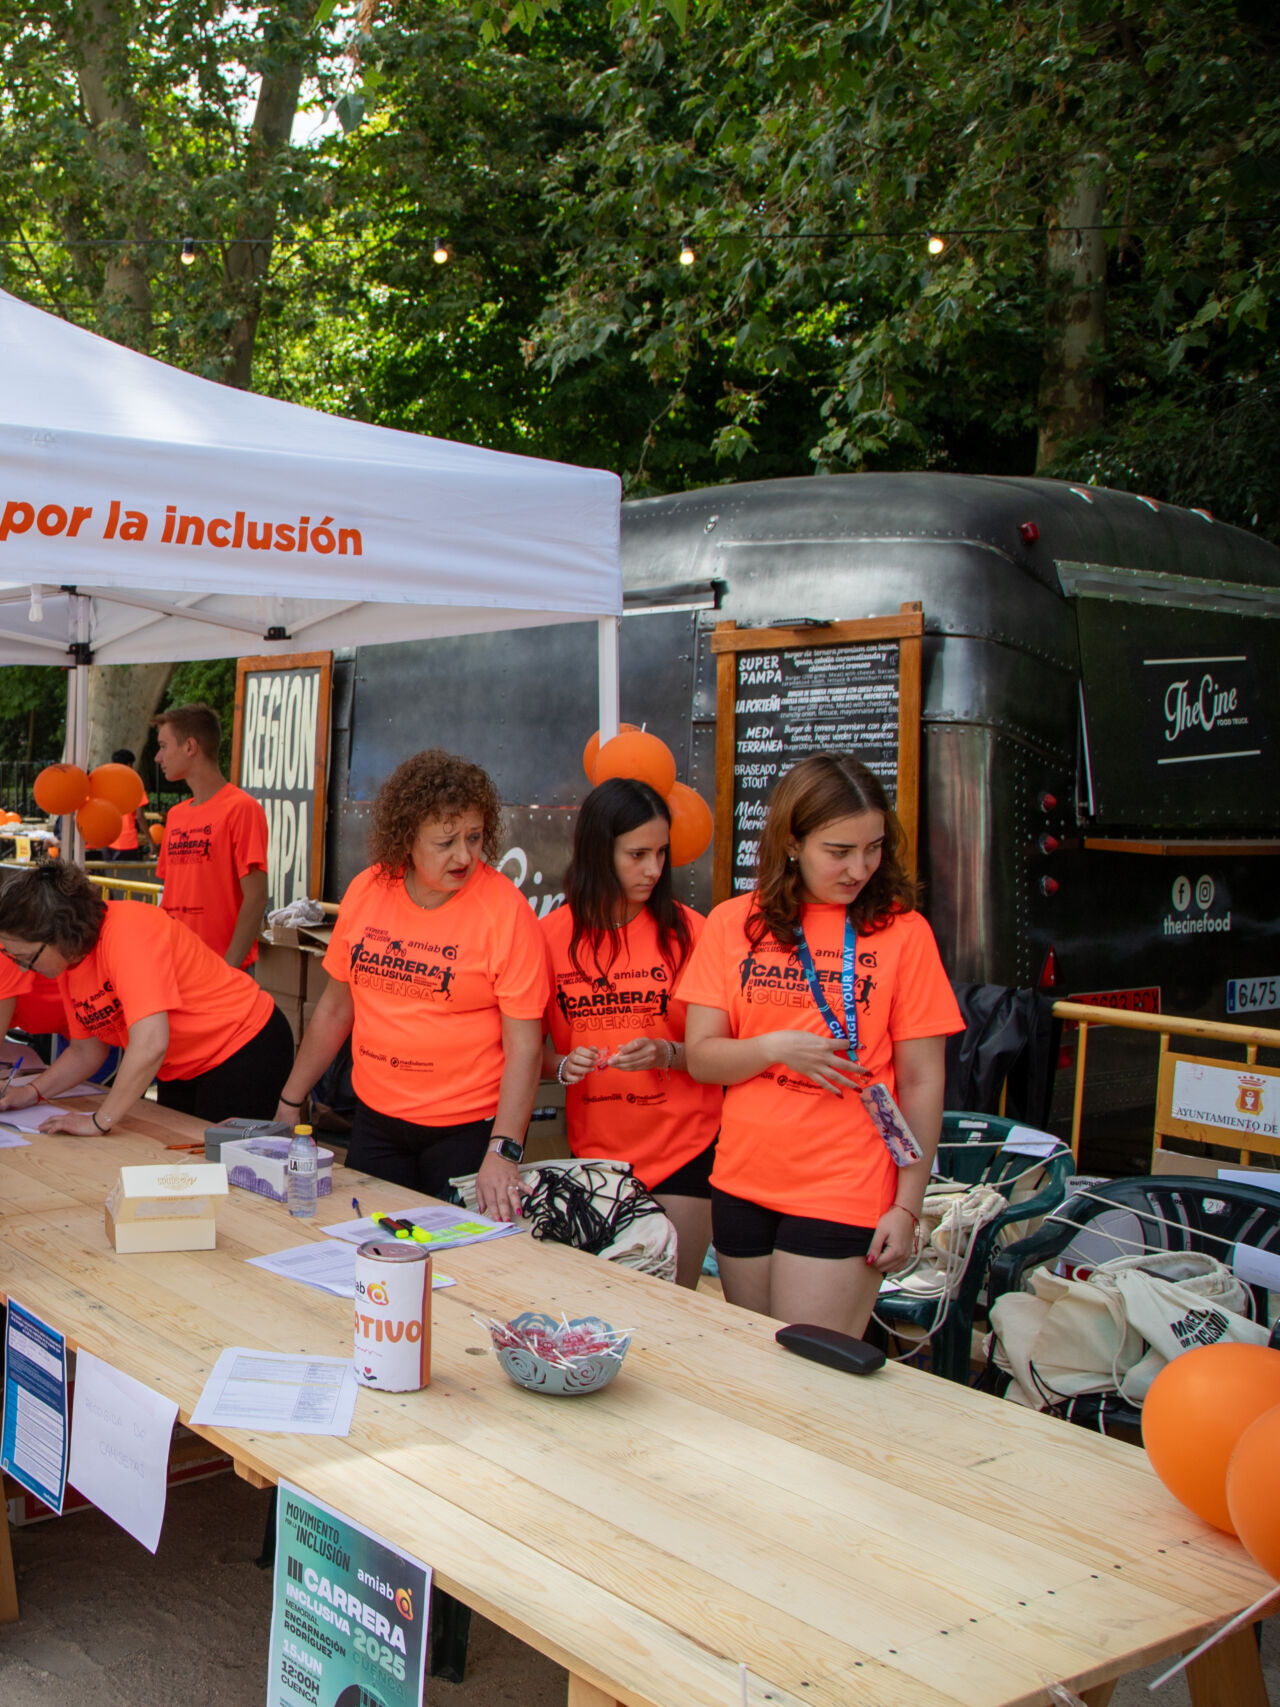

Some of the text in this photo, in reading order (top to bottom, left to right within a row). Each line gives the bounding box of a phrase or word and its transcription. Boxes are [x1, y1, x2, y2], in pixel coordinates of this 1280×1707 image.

[102, 501, 149, 542] la
[160, 505, 363, 556] inclusión
[738, 655, 779, 671] SUPER
[740, 670, 782, 685] PAMPA
[242, 674, 320, 790] REGION
[746, 726, 774, 739] MEDI
[866, 722, 879, 730] con
[737, 740, 782, 753] TERRANEA
[734, 764, 777, 776] BRASEADO
[742, 776, 768, 789] STOUT
[1163, 911, 1231, 935] thecinefood
[408, 939, 441, 953] amiab
[842, 945, 855, 970] WAY
[358, 950, 441, 977] CARRERA
[358, 964, 413, 983] INCLUSIVA
[614, 969, 649, 980] amiab
[358, 972, 435, 1001] CUENCA
[566, 990, 659, 1009] CARRERA
[842, 975, 856, 1012] YOUR
[1238, 981, 1277, 1008] 6475
[570, 1005, 632, 1018] INCLUSIVA
[573, 1014, 656, 1032] CUENCA
[1176, 1106, 1278, 1135] AYUNTAMIENTO DE
[286, 1501, 340, 1545] MOVIMIENTO
[296, 1525, 351, 1572] INCLUSIÓN
[357, 1568, 394, 1600] amiab
[286, 1598, 319, 1626] MEMORIAL
[287, 1555, 407, 1656] III CARRERA
[284, 1620, 333, 1659] RODRÍGUEZ
[285, 1609, 346, 1657] ENCARNACIÓN
[286, 1582, 351, 1637] INCLUSIVA
[353, 1627, 406, 1681] 2025
[280, 1674, 318, 1706] CUENCA
[281, 1660, 320, 1696] 12:00H
